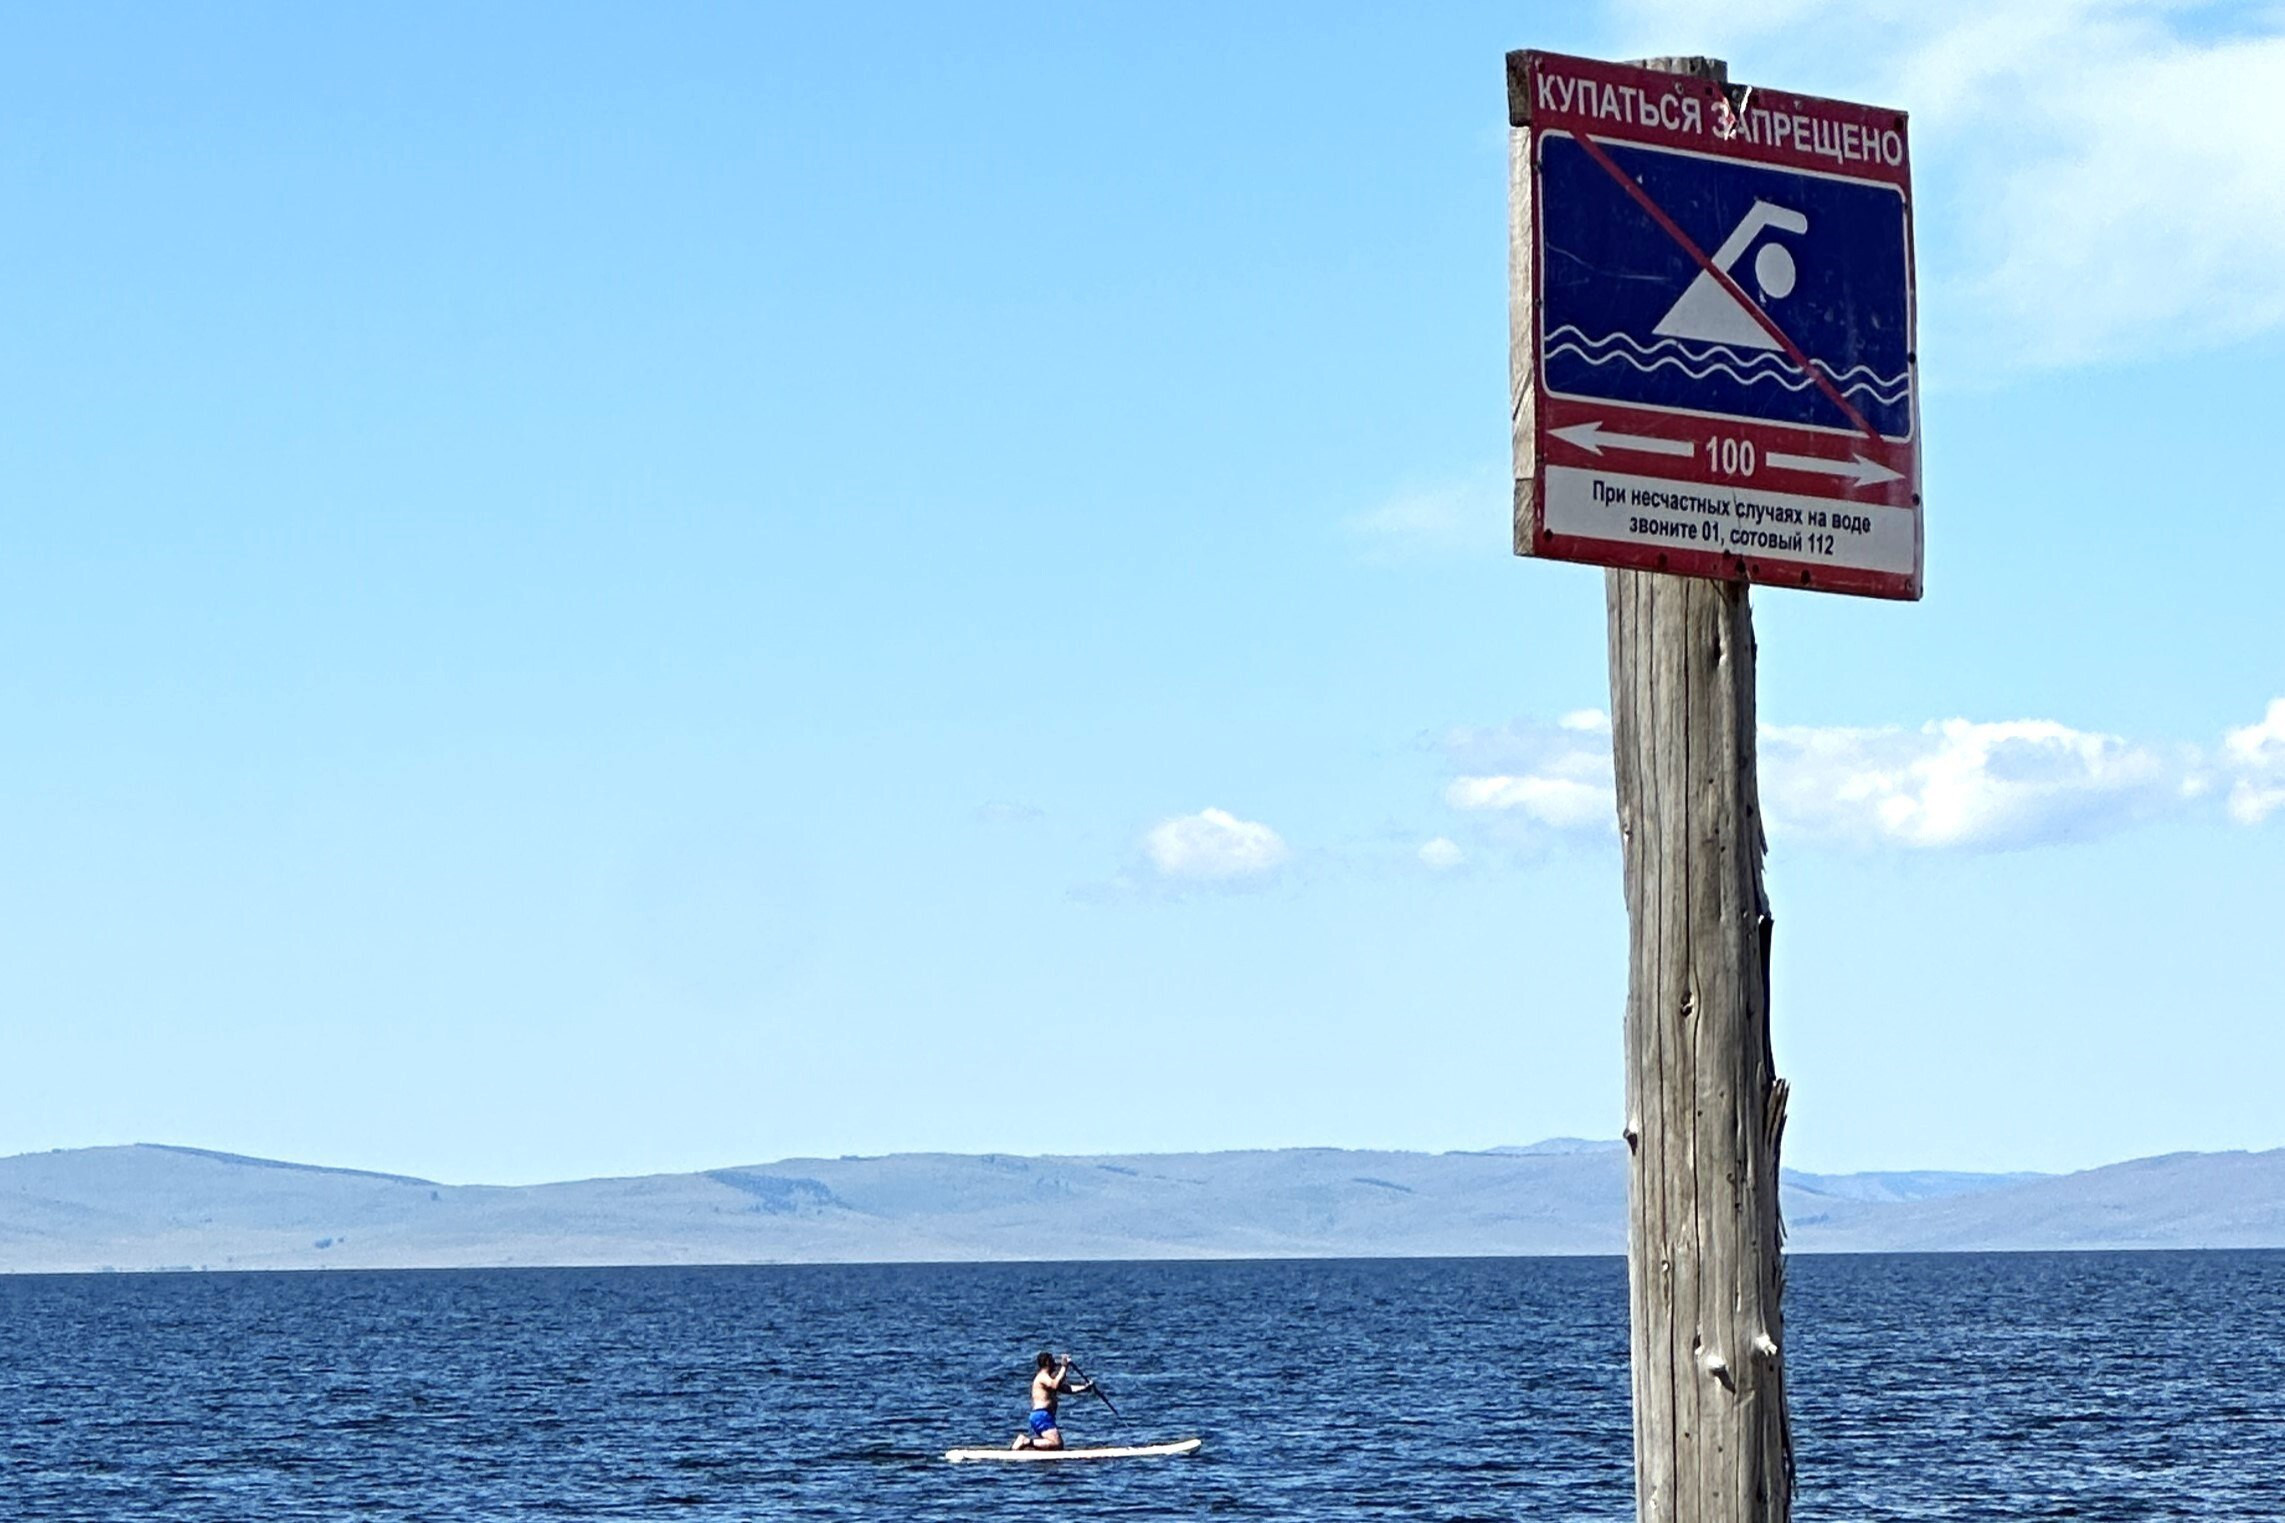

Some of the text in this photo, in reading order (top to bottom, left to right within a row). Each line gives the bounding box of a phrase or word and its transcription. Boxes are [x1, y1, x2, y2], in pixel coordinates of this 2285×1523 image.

[1537, 73, 1702, 134] КУПАТЬСЯ
[1706, 436, 1756, 477] 100
[1592, 480, 1872, 534] При несчастных случаях на воде
[1629, 516, 1835, 556] звоните 01, сотовый 112
